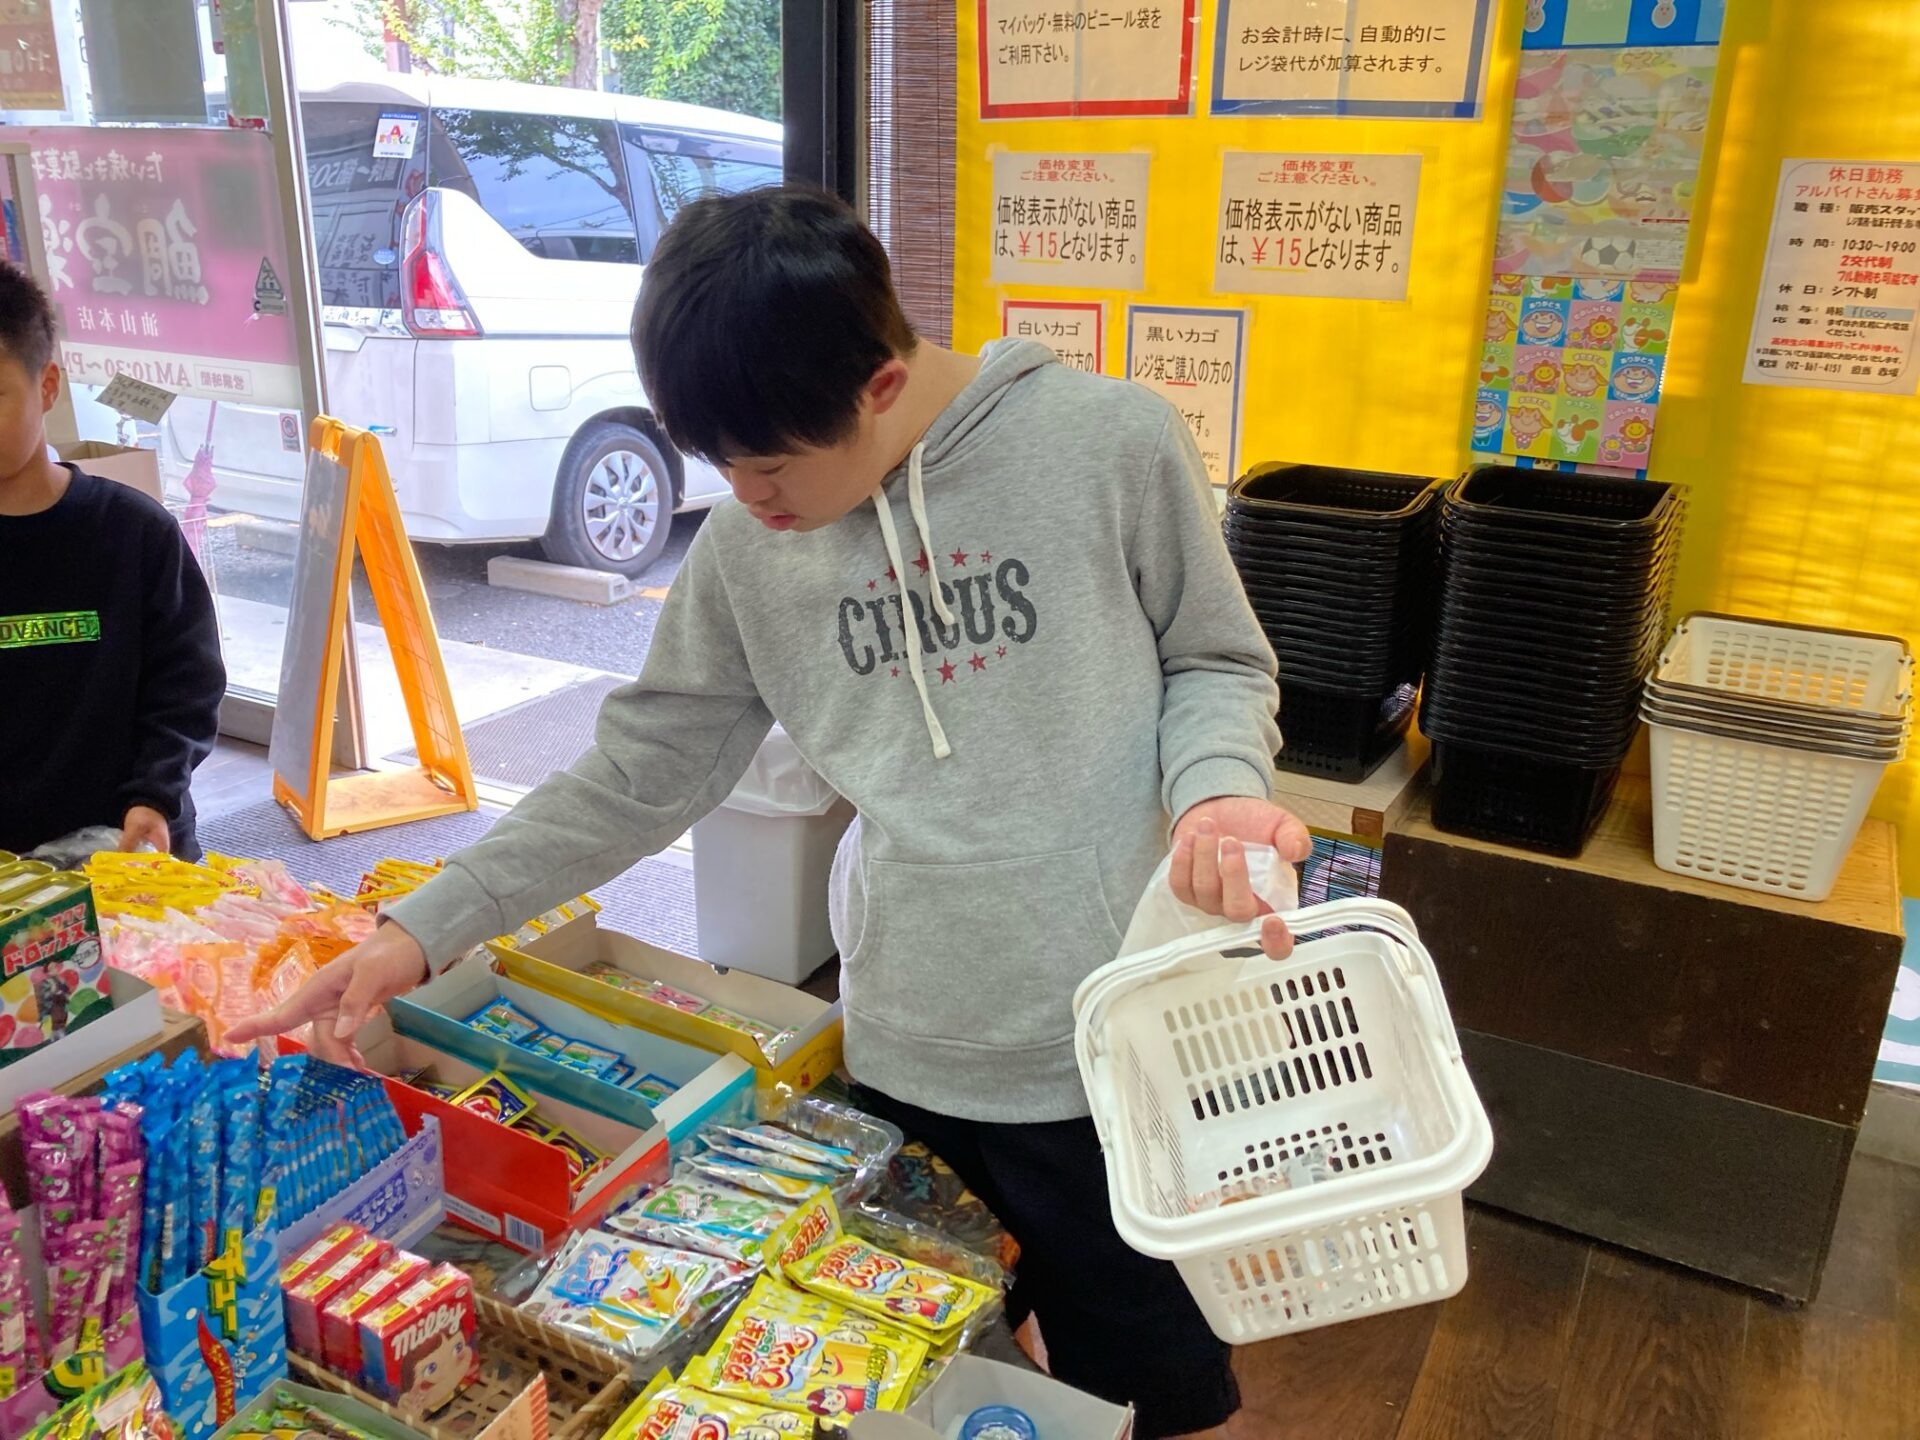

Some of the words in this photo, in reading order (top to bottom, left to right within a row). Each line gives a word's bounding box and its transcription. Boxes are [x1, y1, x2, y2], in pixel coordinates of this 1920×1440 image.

[998, 9, 1162, 35] マイバッグ・無料のビニール袋を
[1241, 24, 1447, 45] お会計時に、自動的に
[998, 43, 1070, 65] ご利用下さい。
[1238, 54, 1444, 75] レジ袋代が加算されます。
[1038, 159, 1096, 171] 価格変更
[1282, 160, 1355, 173] 価格変更
[1829, 166, 1904, 184] 休日勤務
[1020, 170, 1115, 183] ご注意ください。
[1257, 172, 1377, 187] ご注意ください。
[997, 195, 1137, 229] 価格表示がない商品
[1225, 198, 1402, 237] 価格表示がない商品
[1832, 286, 1878, 300] シフト制
[1018, 321, 1081, 337] 白いカゴ
[1146, 326, 1219, 344] 黒いカゴ
[1134, 354, 1232, 384] レジ袋ご購入の方の
[838, 558, 1037, 676] CIRCUS
[391, 1303, 467, 1361] Milky
